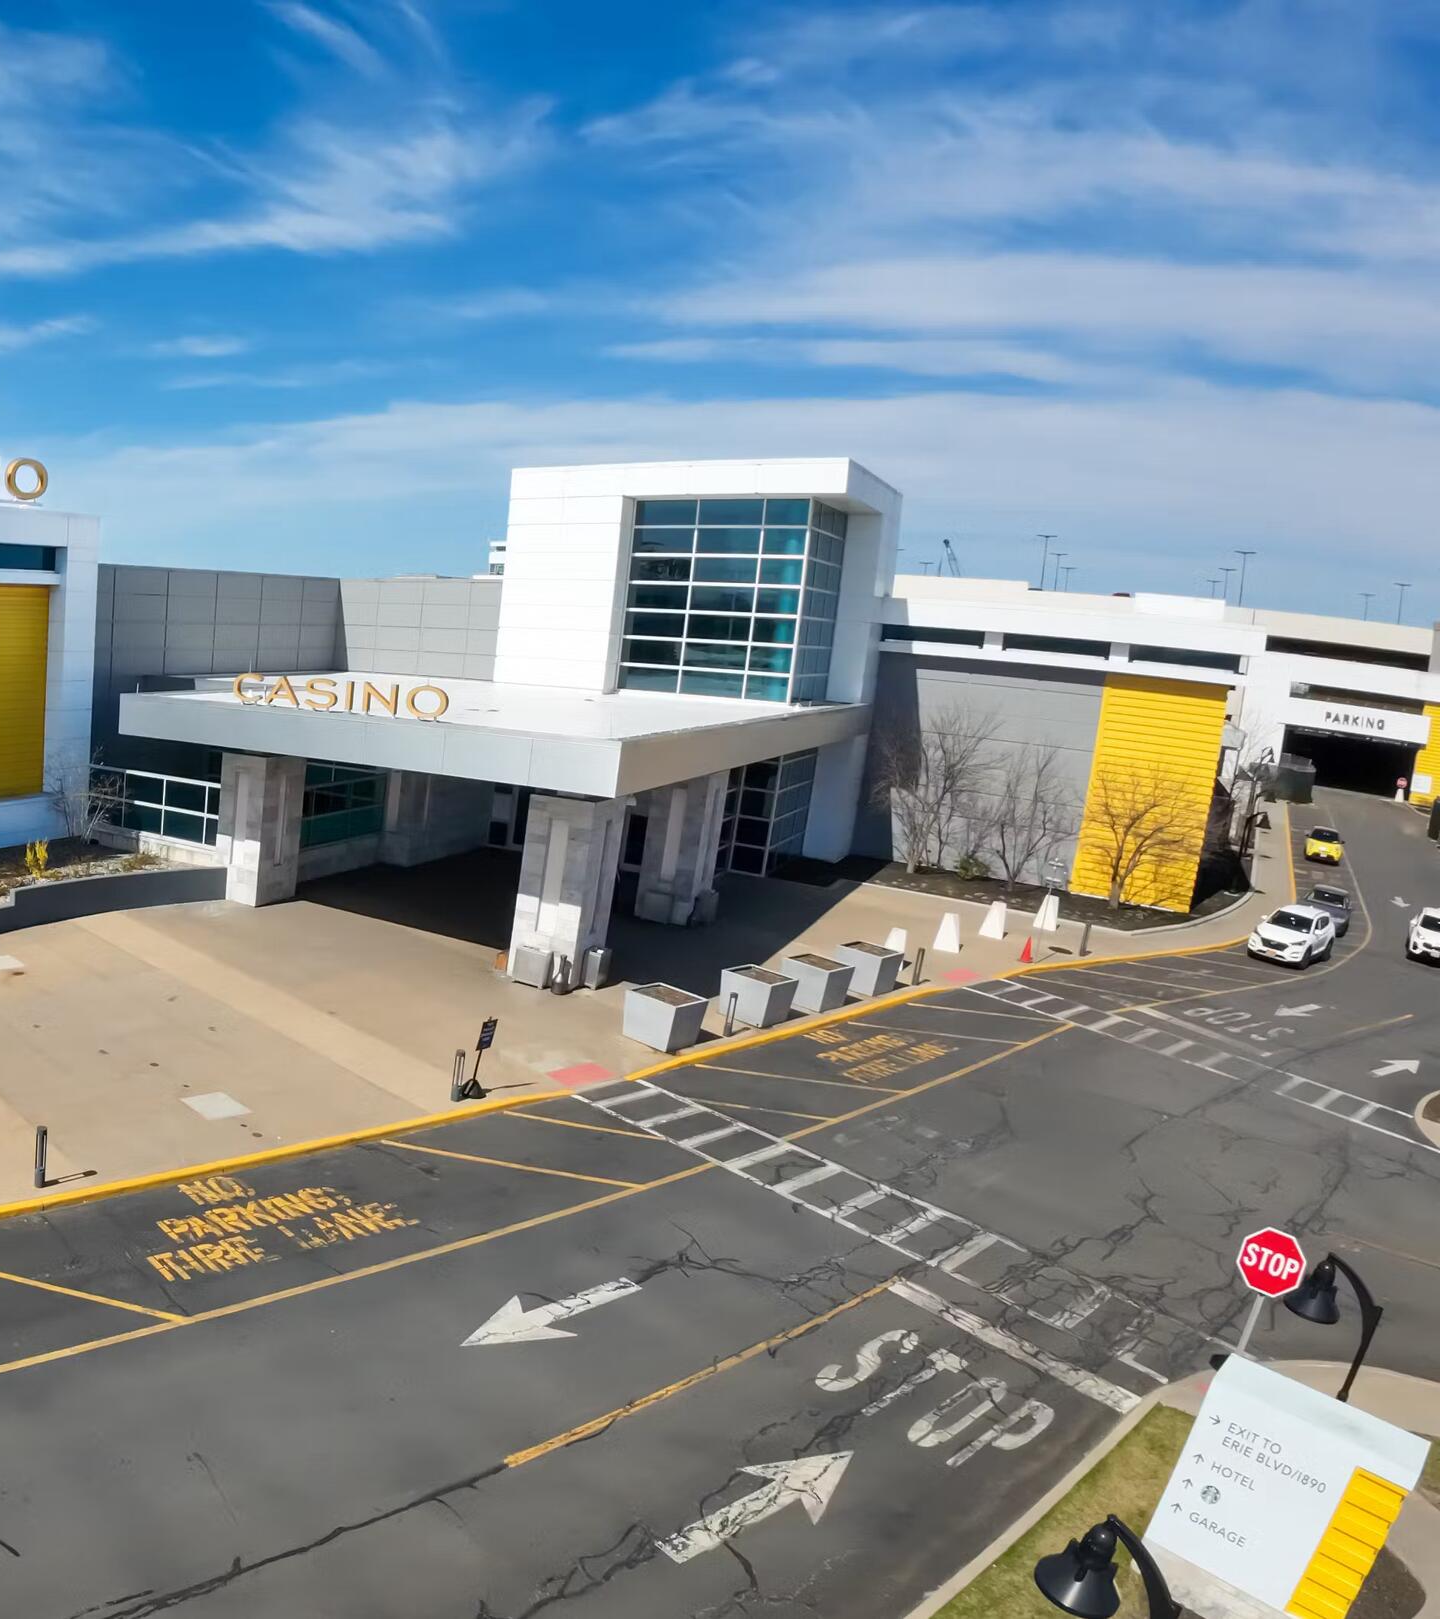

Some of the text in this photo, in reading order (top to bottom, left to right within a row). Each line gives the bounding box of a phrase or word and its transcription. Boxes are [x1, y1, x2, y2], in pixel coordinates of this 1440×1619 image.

[233, 673, 449, 719] CASINO
[1324, 711, 1385, 731] PARKING
[176, 1175, 256, 1206] NO
[156, 1186, 346, 1244] PARKING
[1243, 1242, 1300, 1280] STOP
[815, 1329, 1055, 1467] STOP
[1221, 1436, 1254, 1458] ERIE
[1227, 1422, 1282, 1455] EXIT TO
[1211, 1461, 1255, 1492] HOTEL
[1189, 1511, 1246, 1548] GARAGE
